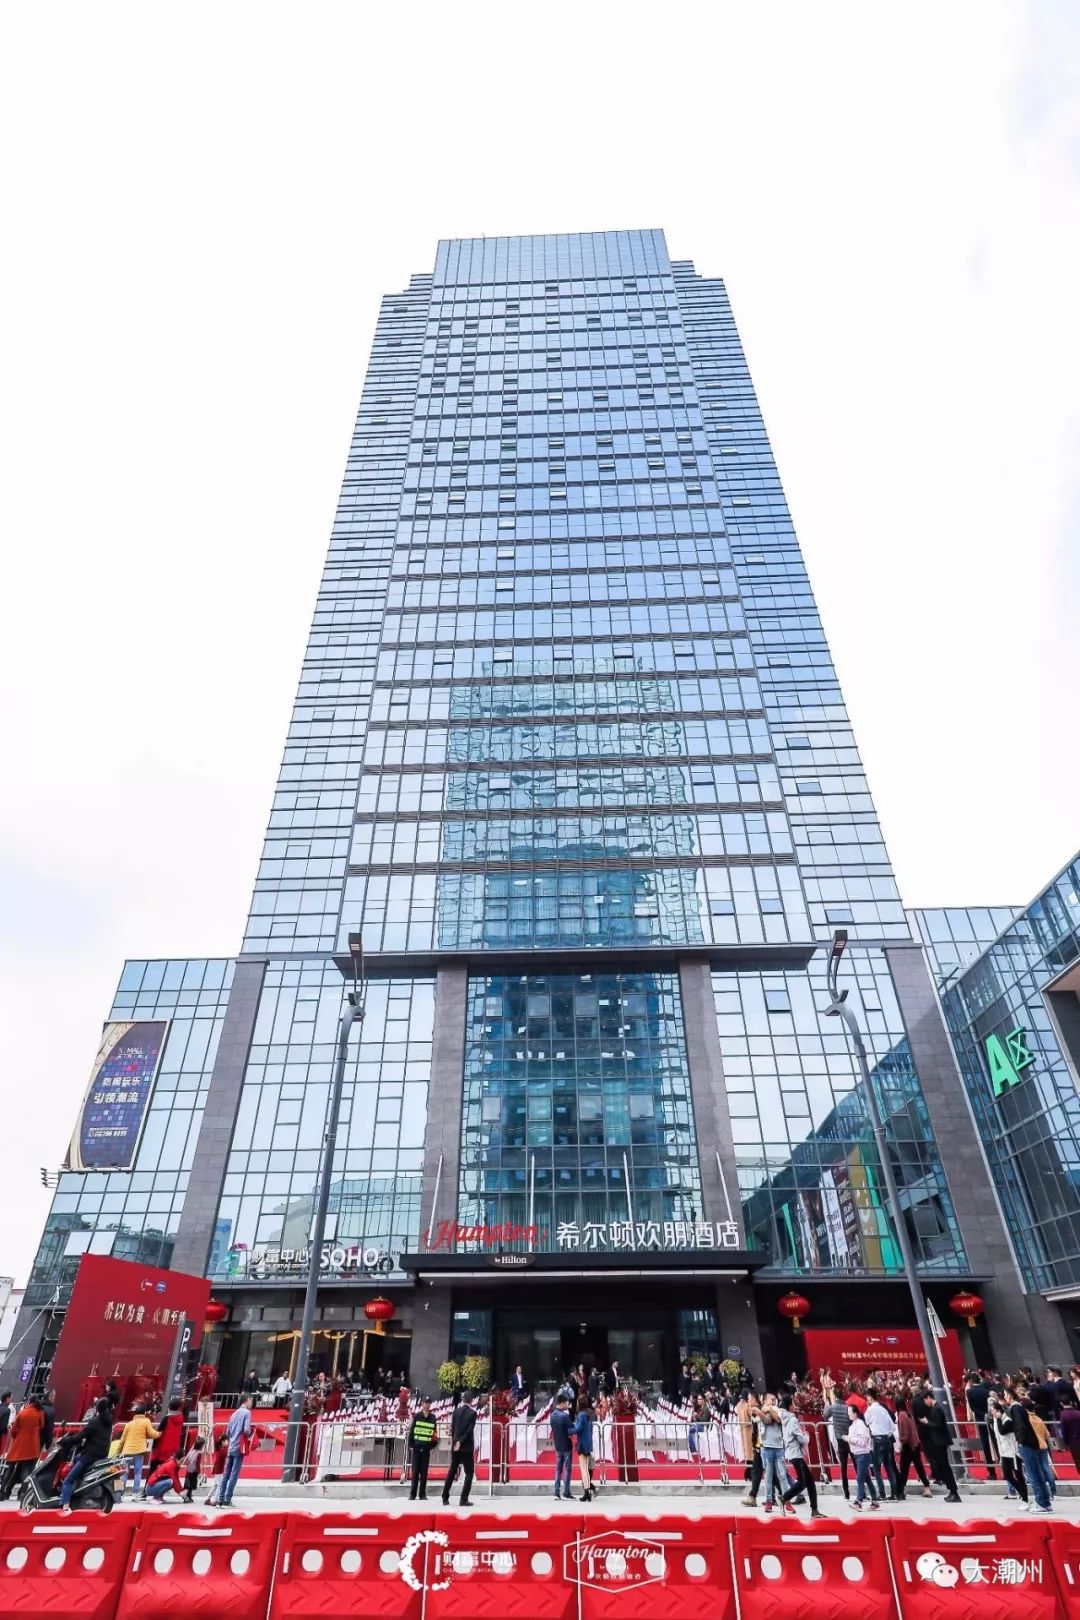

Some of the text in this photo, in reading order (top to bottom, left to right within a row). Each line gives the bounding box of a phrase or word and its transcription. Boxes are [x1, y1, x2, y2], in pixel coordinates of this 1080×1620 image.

[985, 1026, 1035, 1097] A区
[94, 1091, 139, 1104] 引领潮流
[423, 1218, 548, 1250] Hampton
[556, 1221, 740, 1249] 希尔顿欢朋酒店
[319, 1246, 379, 1268] SOHO
[501, 1255, 527, 1264] Hilton
